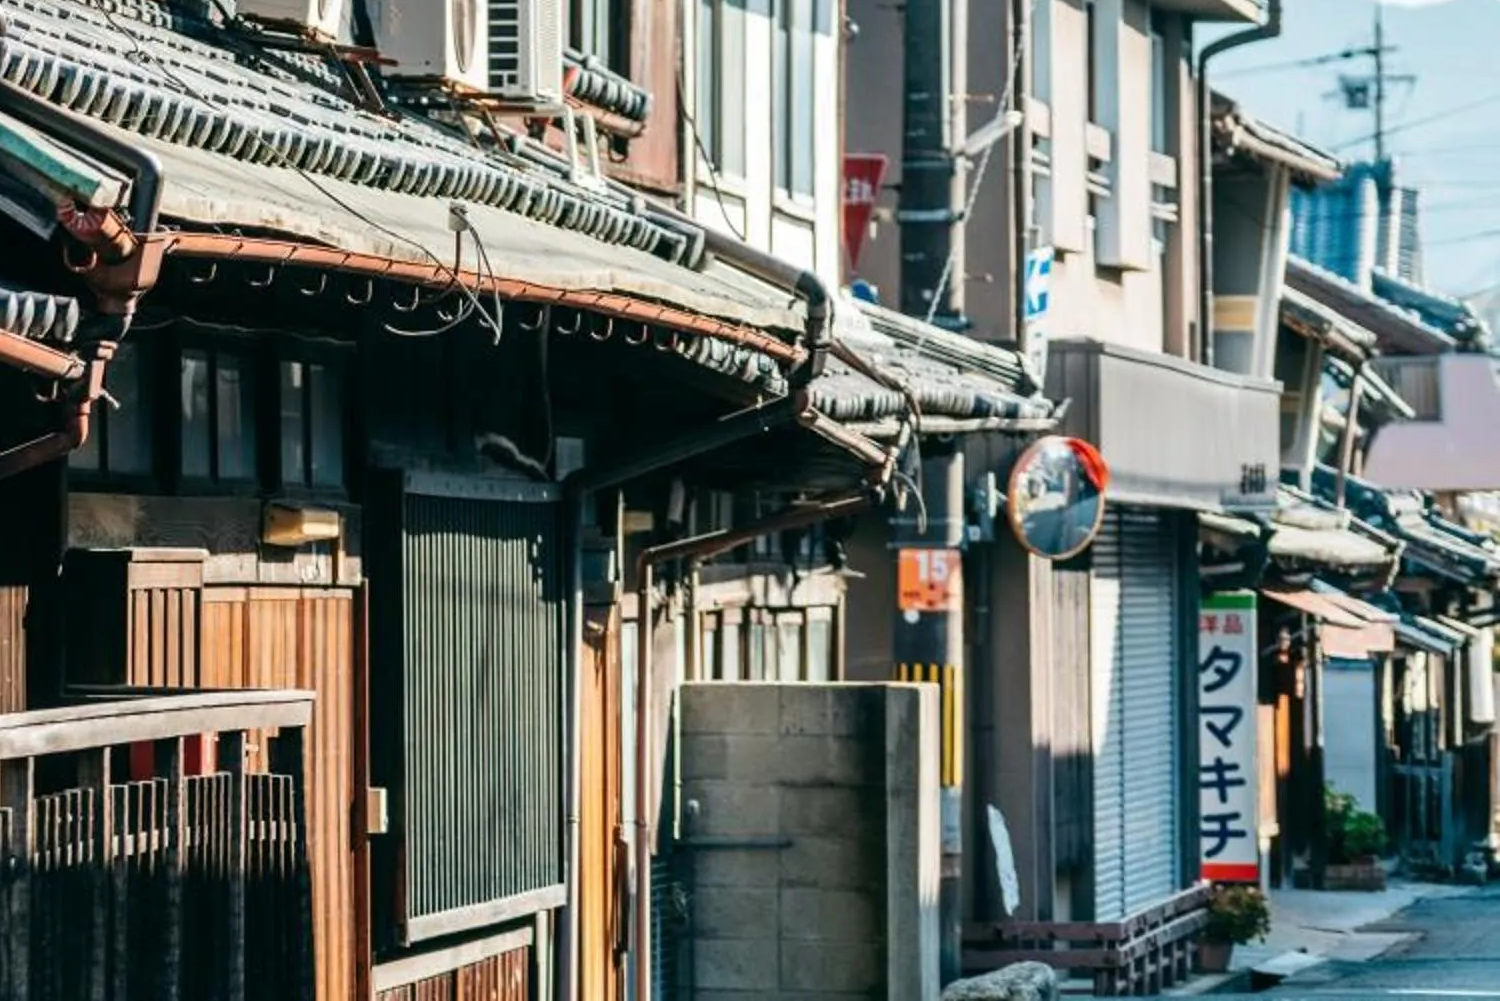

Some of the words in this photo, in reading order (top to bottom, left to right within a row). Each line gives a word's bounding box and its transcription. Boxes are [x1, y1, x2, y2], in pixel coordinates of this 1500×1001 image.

[915, 550, 948, 582] 15
[1199, 645, 1247, 859] タマキチ
